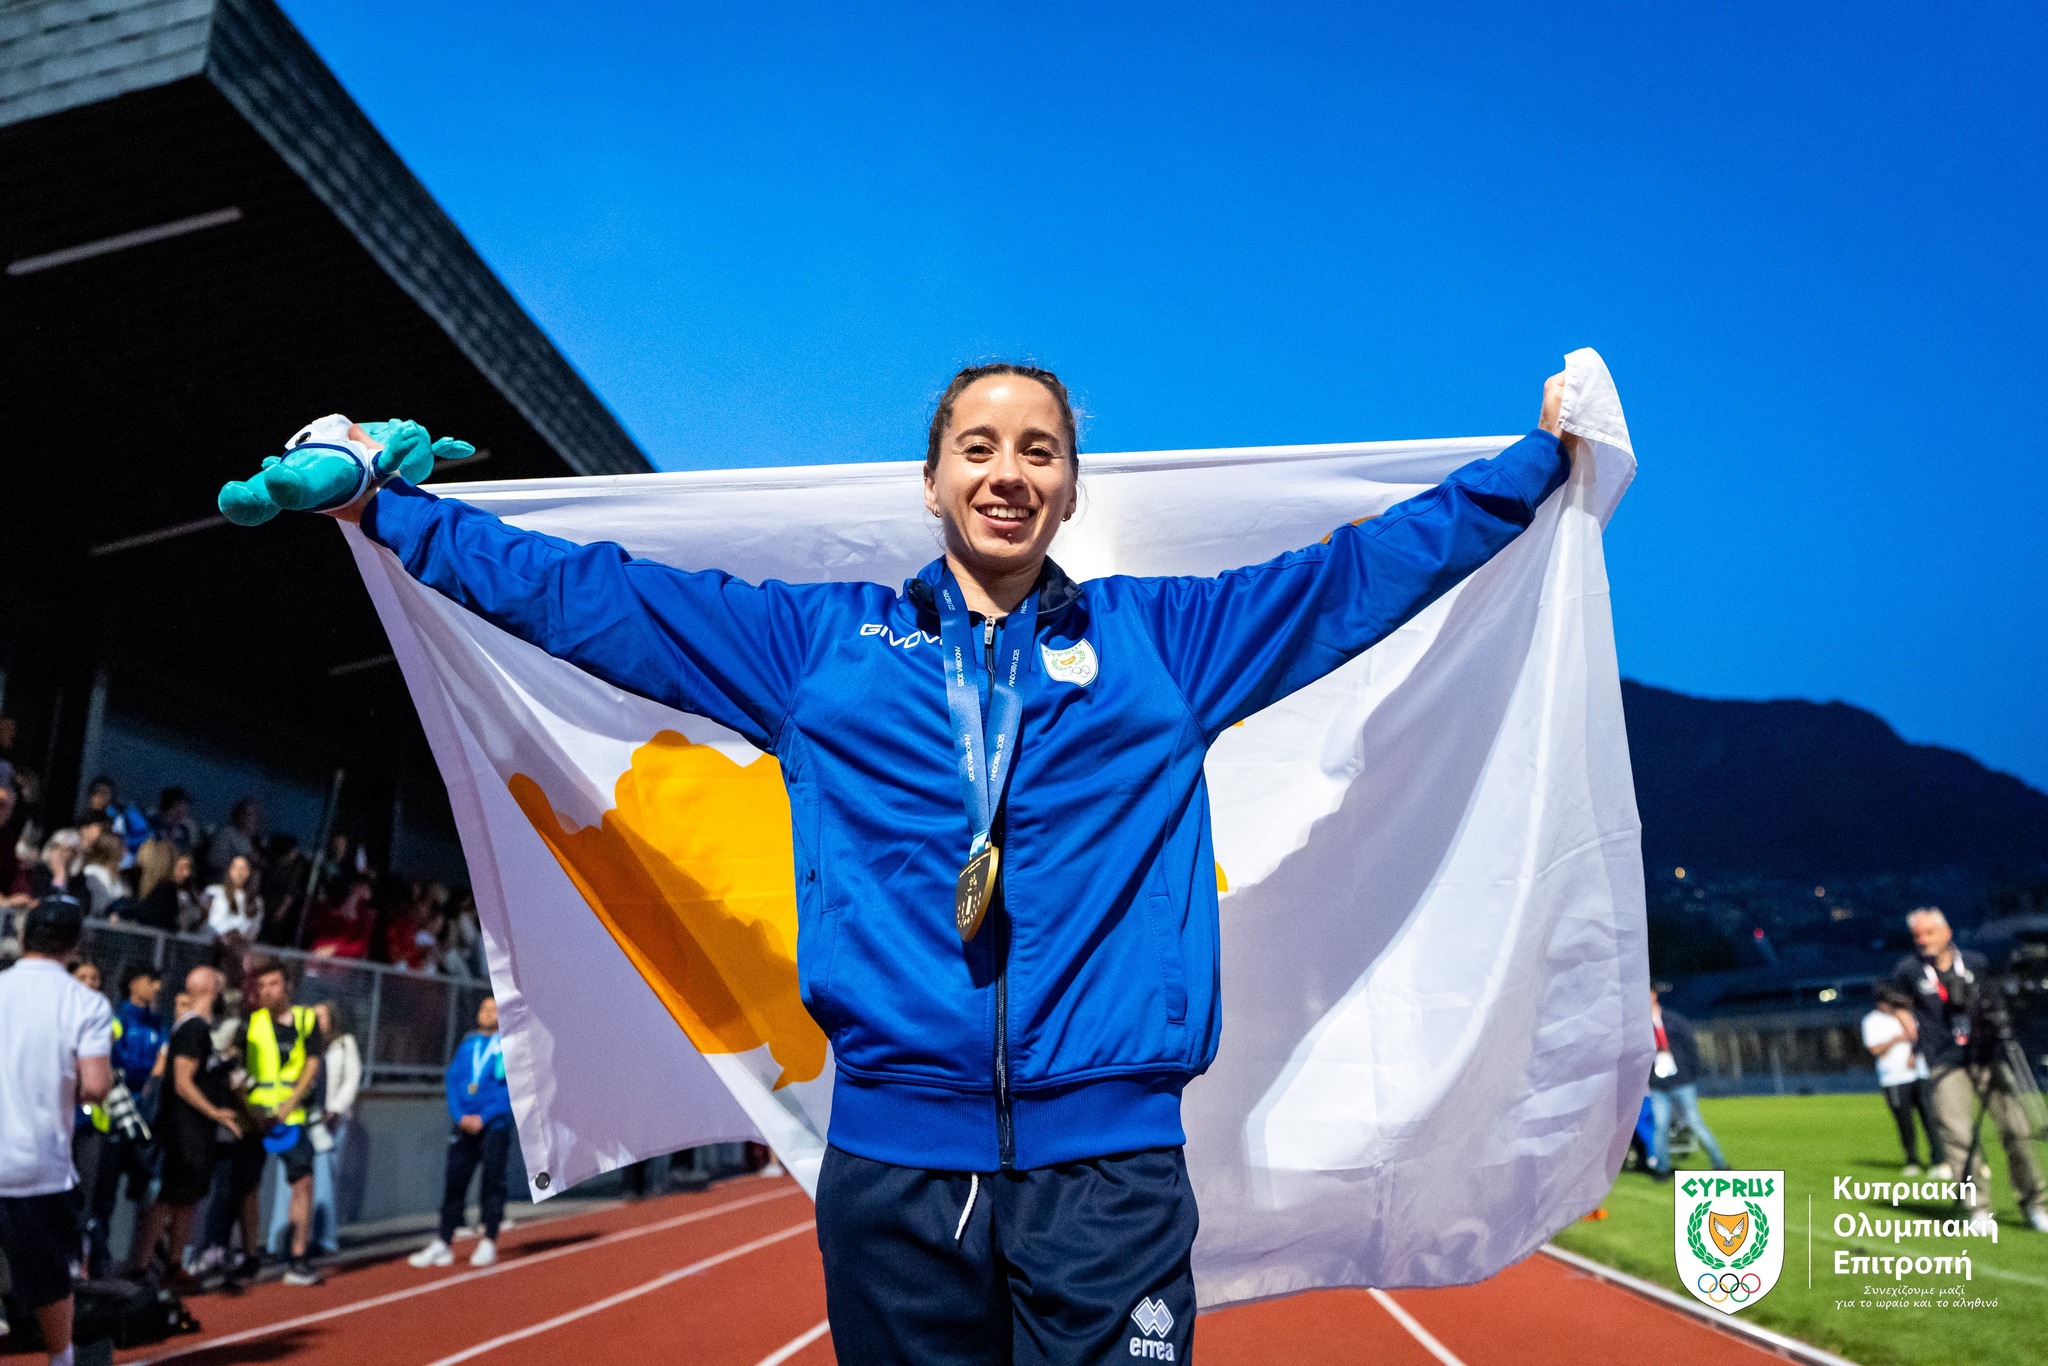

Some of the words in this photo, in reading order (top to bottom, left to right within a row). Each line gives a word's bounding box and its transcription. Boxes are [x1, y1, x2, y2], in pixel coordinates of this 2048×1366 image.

[860, 623, 943, 649] GIVOV
[954, 645, 963, 672] ANDORRA
[1008, 660, 1018, 687] ANDORRA
[963, 733, 973, 766] ANDORRA
[990, 748, 1002, 781] ANDORRA
